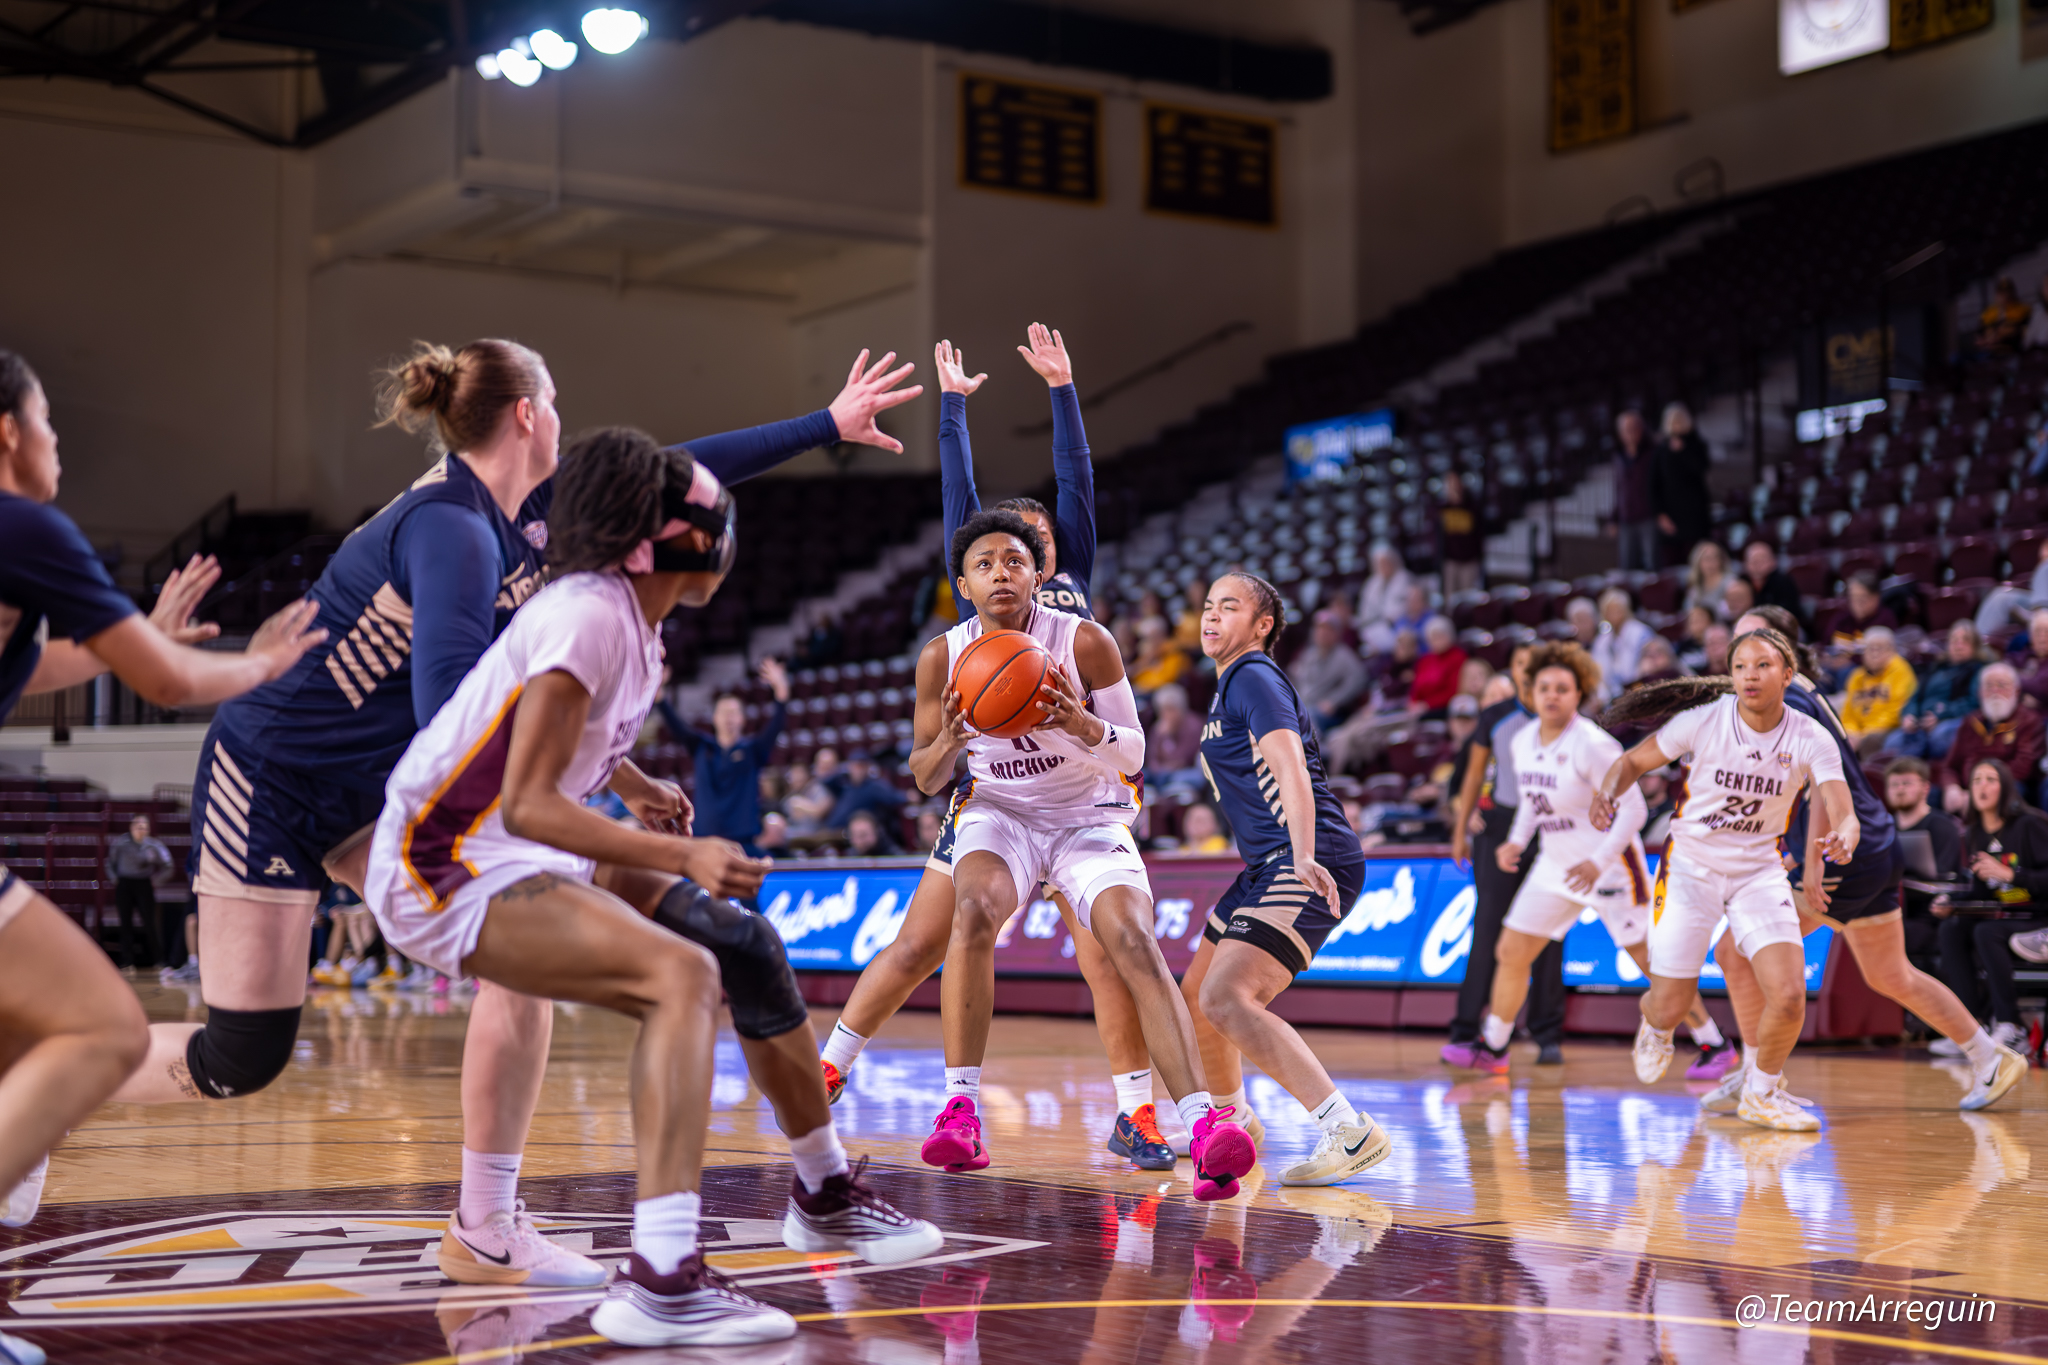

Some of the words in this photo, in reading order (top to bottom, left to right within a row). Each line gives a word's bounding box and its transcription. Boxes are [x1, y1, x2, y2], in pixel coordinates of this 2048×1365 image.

[1036, 590, 1087, 609] RON
[989, 754, 1069, 780] MICHIG
[1714, 769, 1783, 796] CENTRAL
[263, 855, 295, 876] A
